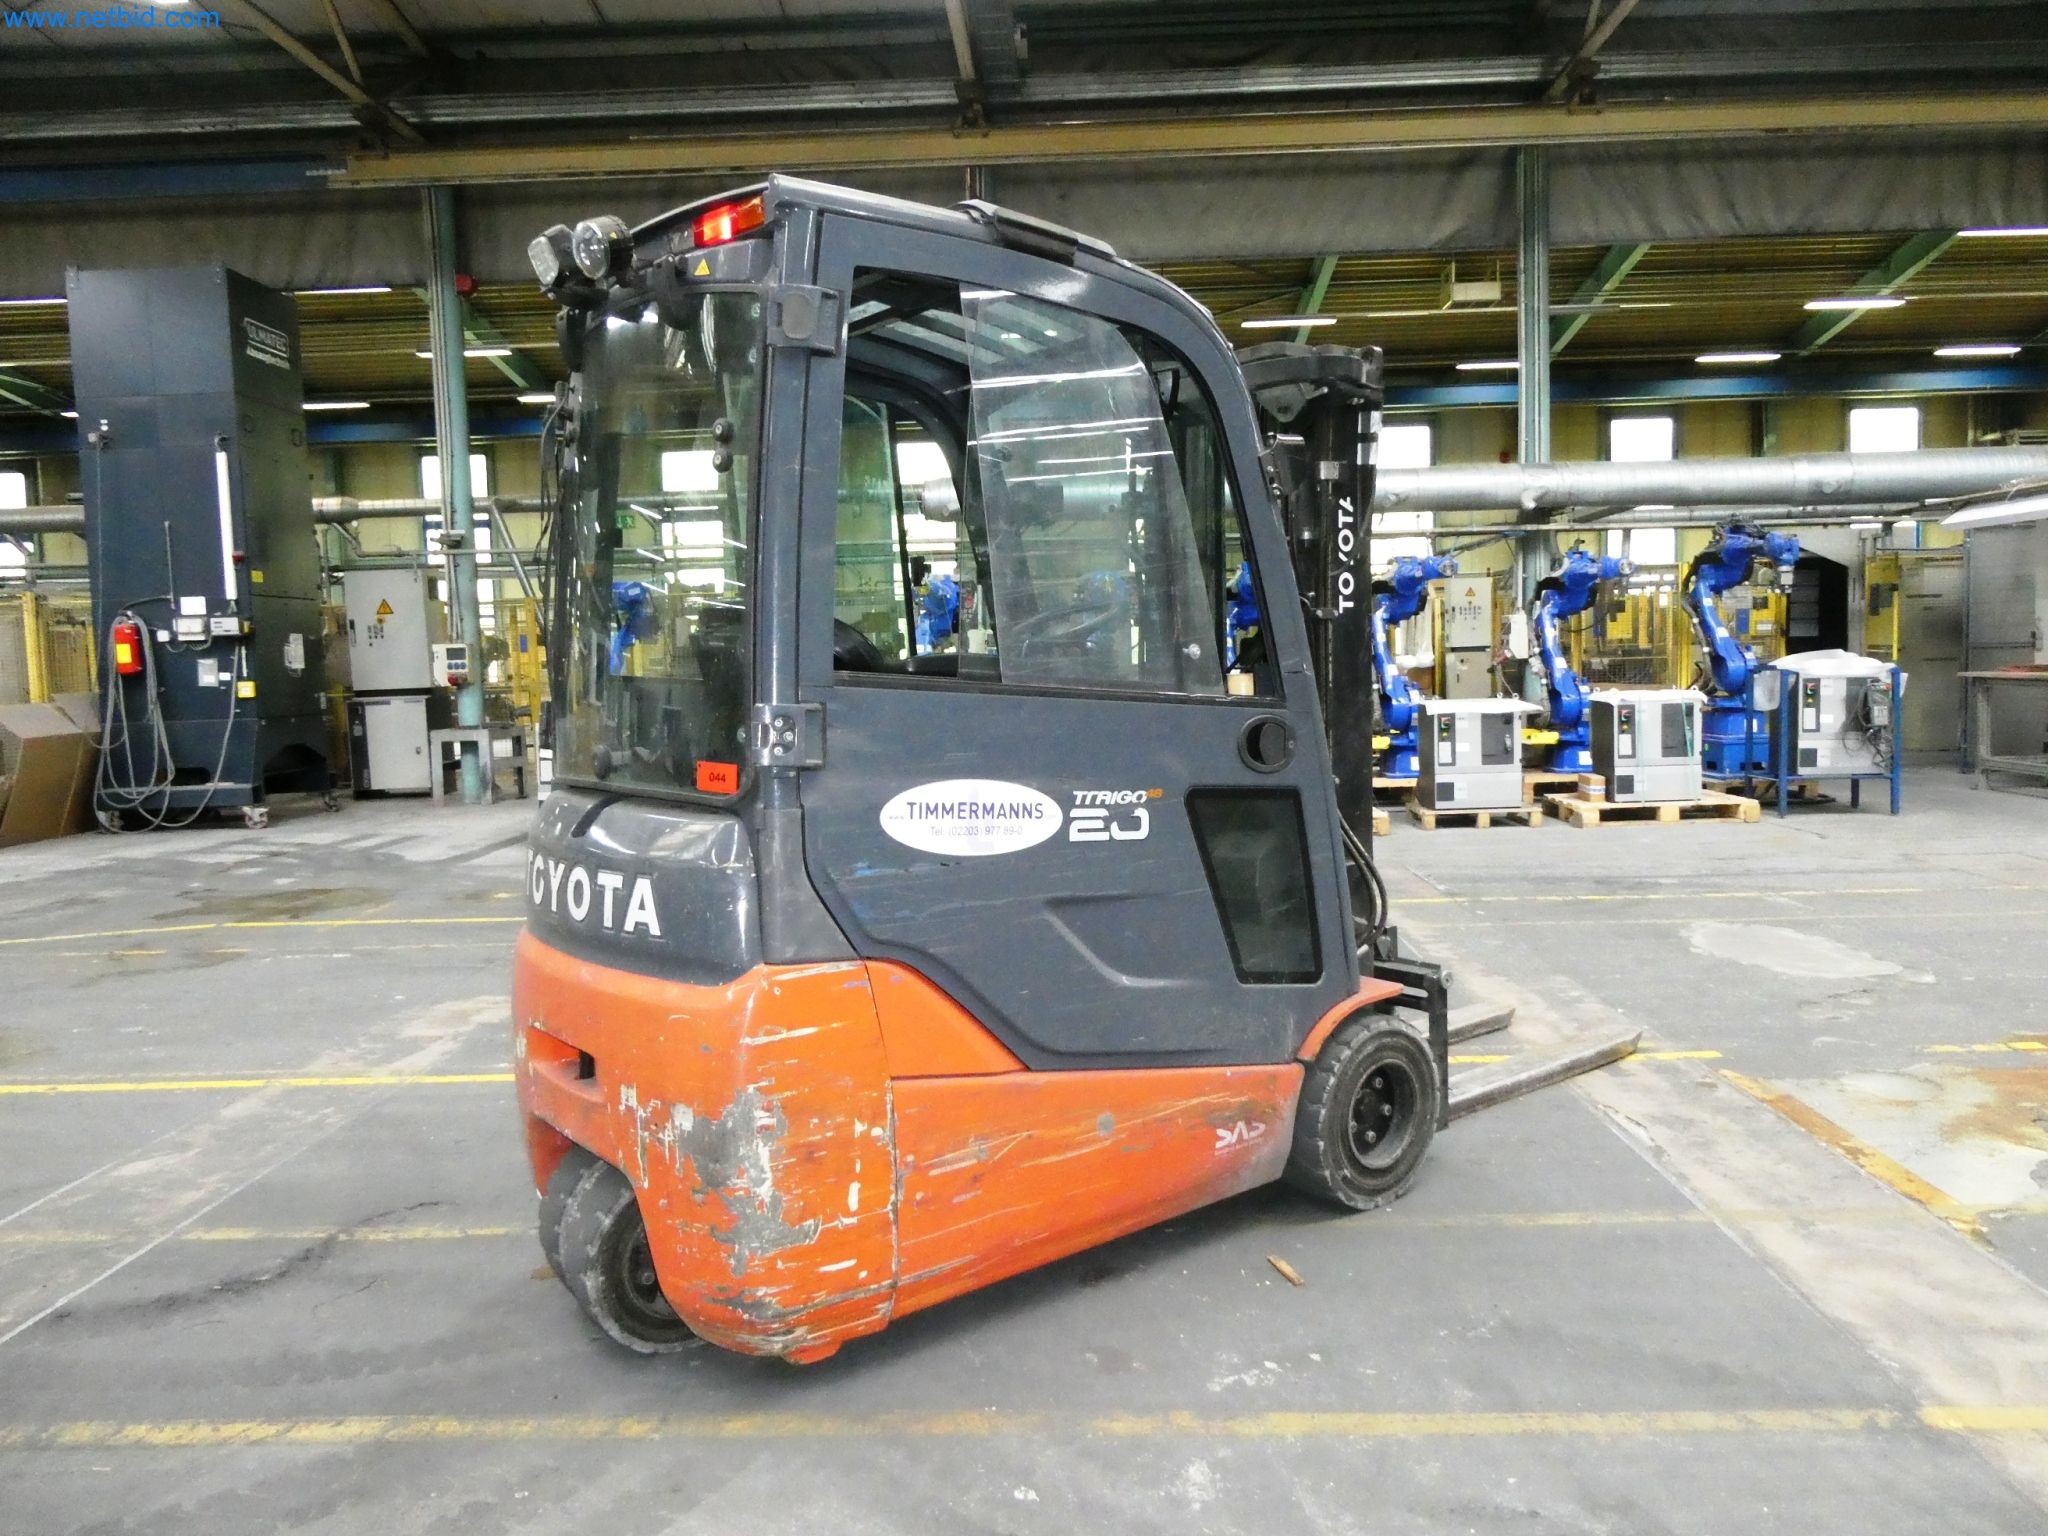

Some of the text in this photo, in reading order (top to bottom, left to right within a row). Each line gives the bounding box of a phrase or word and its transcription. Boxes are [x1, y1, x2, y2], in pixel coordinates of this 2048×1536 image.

[709, 772, 726, 783] 044
[907, 801, 1044, 820] TIMMERMANNS
[985, 825, 1000, 836] 977
